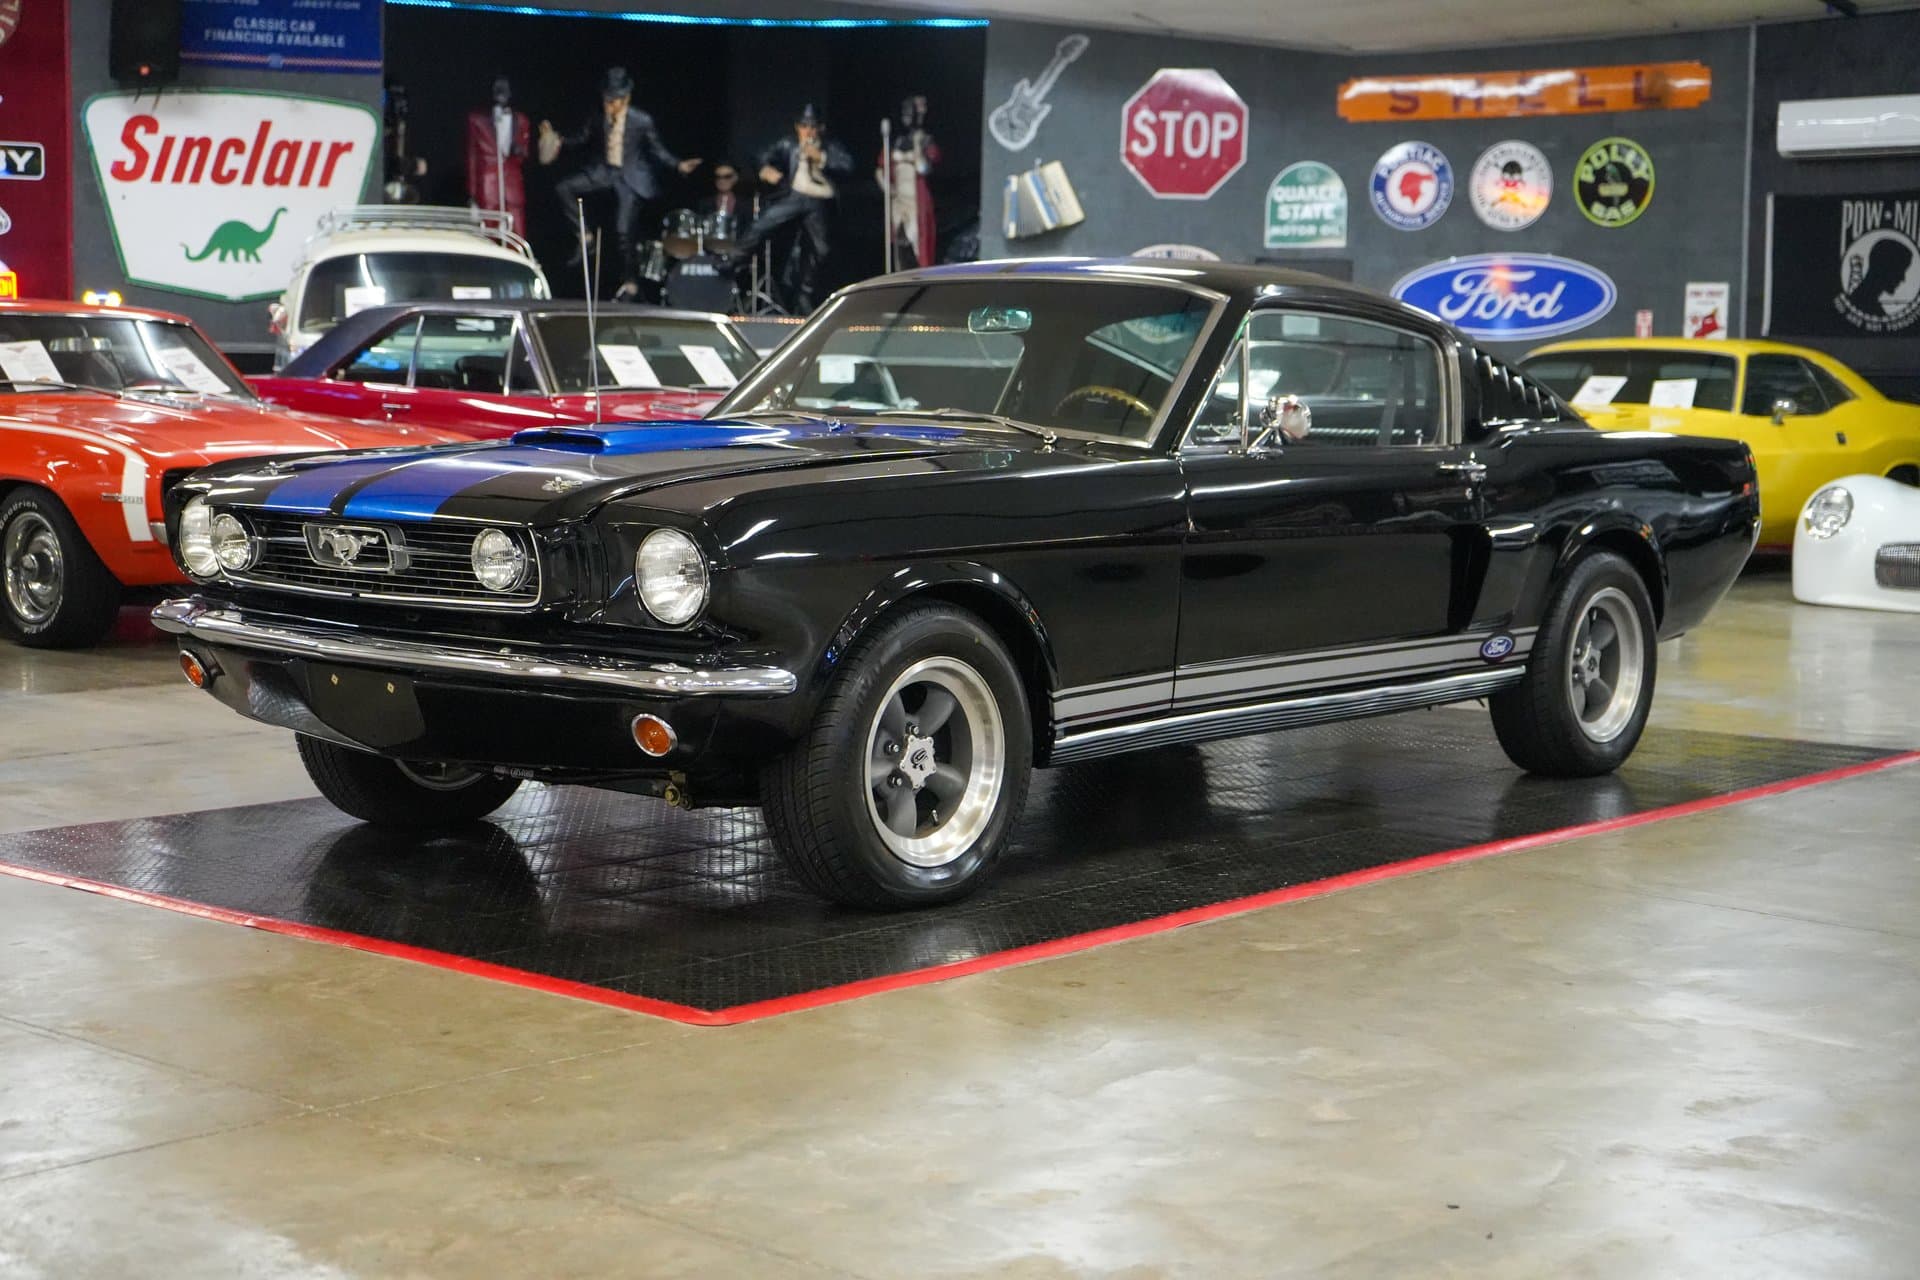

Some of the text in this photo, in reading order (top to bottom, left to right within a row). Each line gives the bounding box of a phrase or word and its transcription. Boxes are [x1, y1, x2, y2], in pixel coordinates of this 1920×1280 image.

[204, 29, 346, 48] FINANCING AVAILABLE
[233, 16, 316, 33] CLASSIC CAR
[1131, 109, 1239, 158] STOP
[110, 114, 354, 188] Sinclair
[1379, 145, 1444, 178] PTIAC
[1580, 144, 1649, 184] POLLY
[1277, 203, 1336, 220] STATE
[1590, 200, 1636, 221] GAS
[1895, 200, 1920, 248] MI
[1270, 224, 1341, 236] MOTOR OIL
[1438, 269, 1567, 320] Ford
